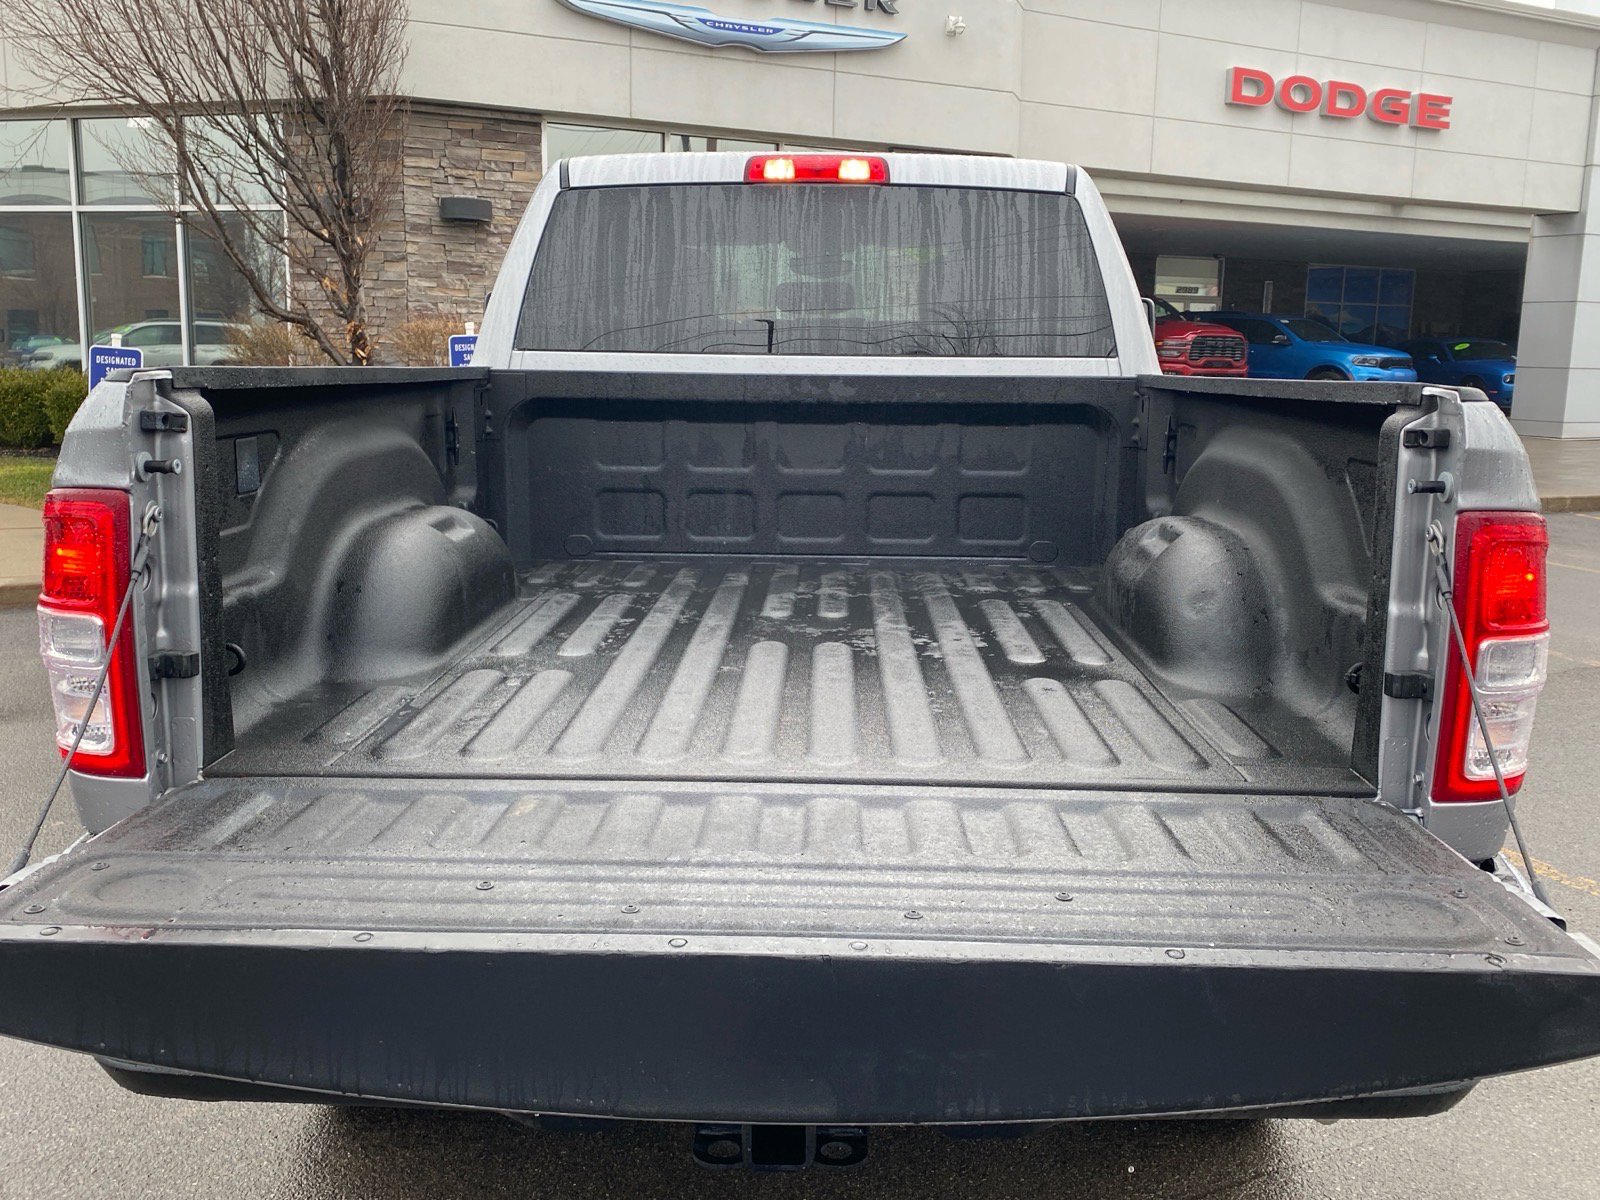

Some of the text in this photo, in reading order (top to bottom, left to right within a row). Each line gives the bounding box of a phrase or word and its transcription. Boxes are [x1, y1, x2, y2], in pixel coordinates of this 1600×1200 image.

[706, 21, 774, 33] CHRYSLER
[1225, 66, 1453, 130] DODGE
[454, 343, 475, 352] DESIGN
[95, 355, 137, 367] DESIGNATED
